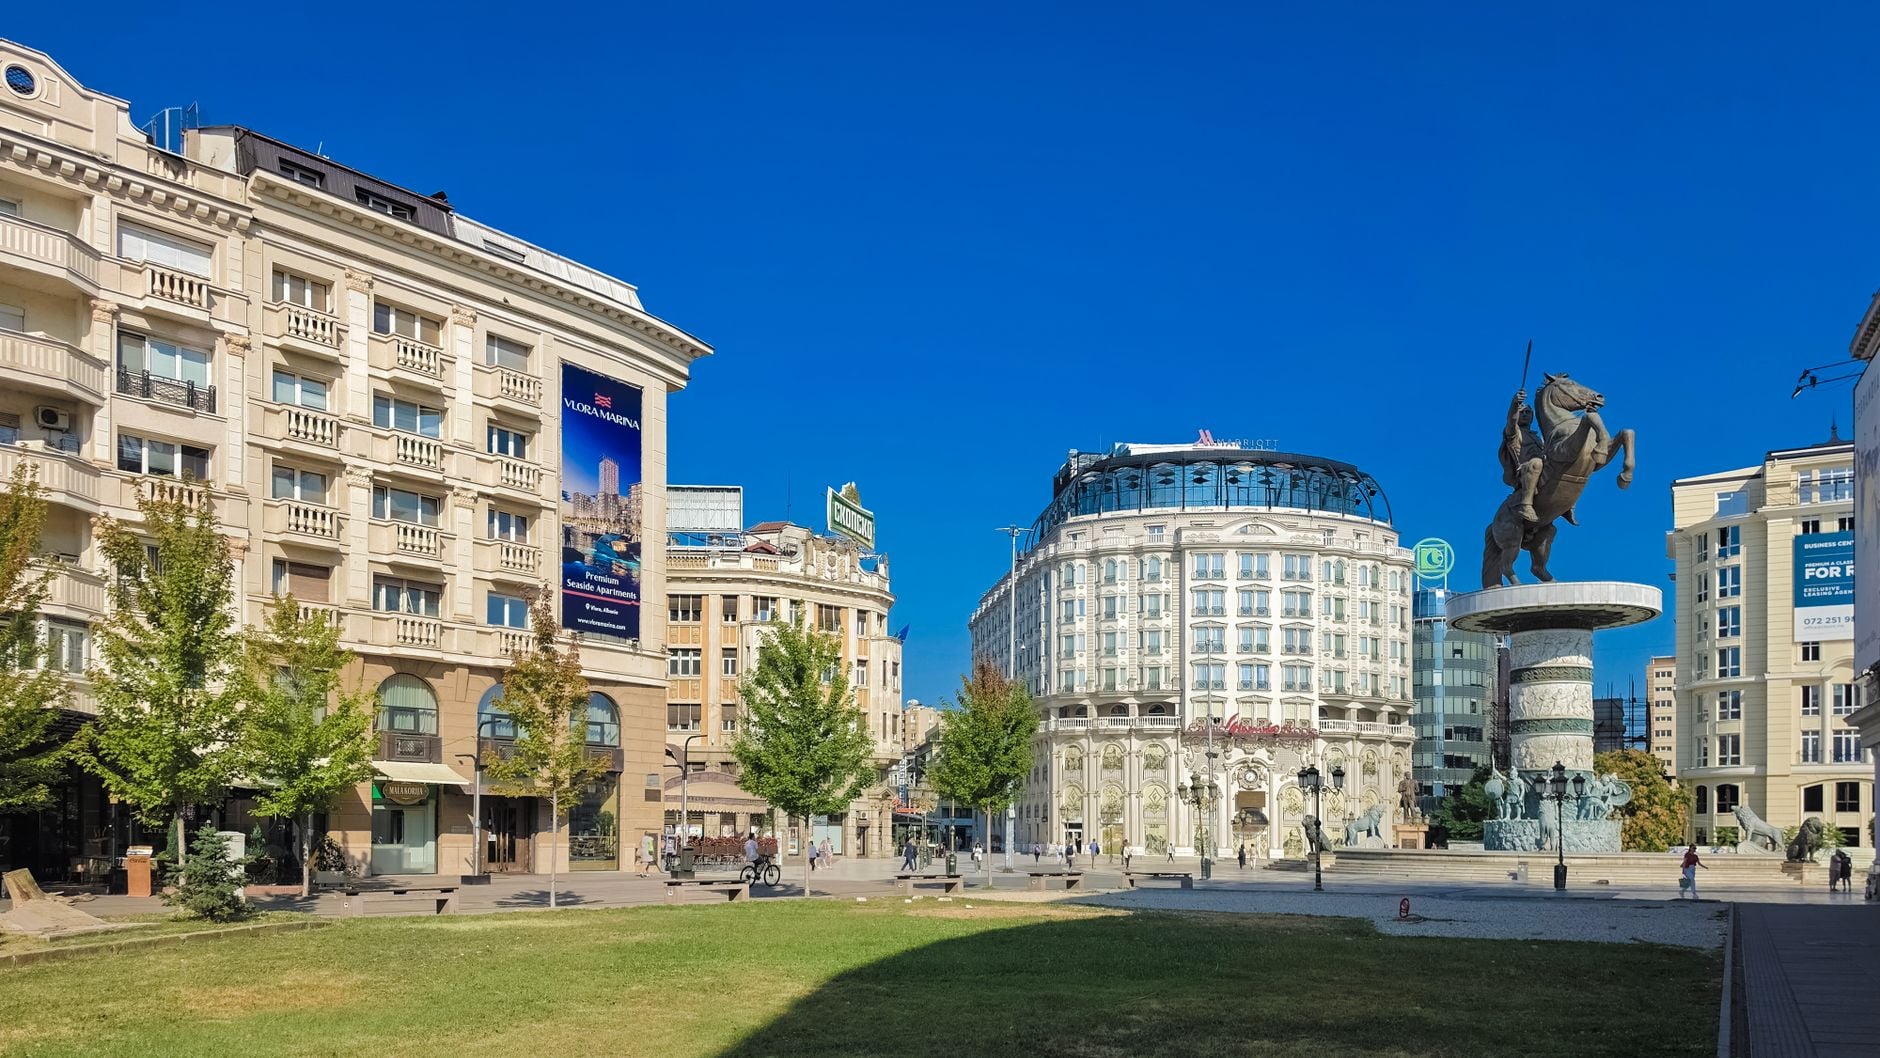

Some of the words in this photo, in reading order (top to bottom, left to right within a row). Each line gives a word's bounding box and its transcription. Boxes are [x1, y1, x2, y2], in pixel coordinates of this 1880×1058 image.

[564, 398, 600, 417] VLORA
[600, 409, 639, 430] MARINA
[1216, 438, 1279, 447] MARRIOTT
[834, 501, 872, 539] СКОПСКО
[1804, 541, 1837, 549] BUSINESS
[585, 571, 619, 585] Premium
[1805, 567, 1841, 579] FOR
[567, 579, 595, 592] Seaside
[596, 585, 637, 600] Apartments
[1804, 617, 1823, 625] 072
[1825, 616, 1842, 624] 251
